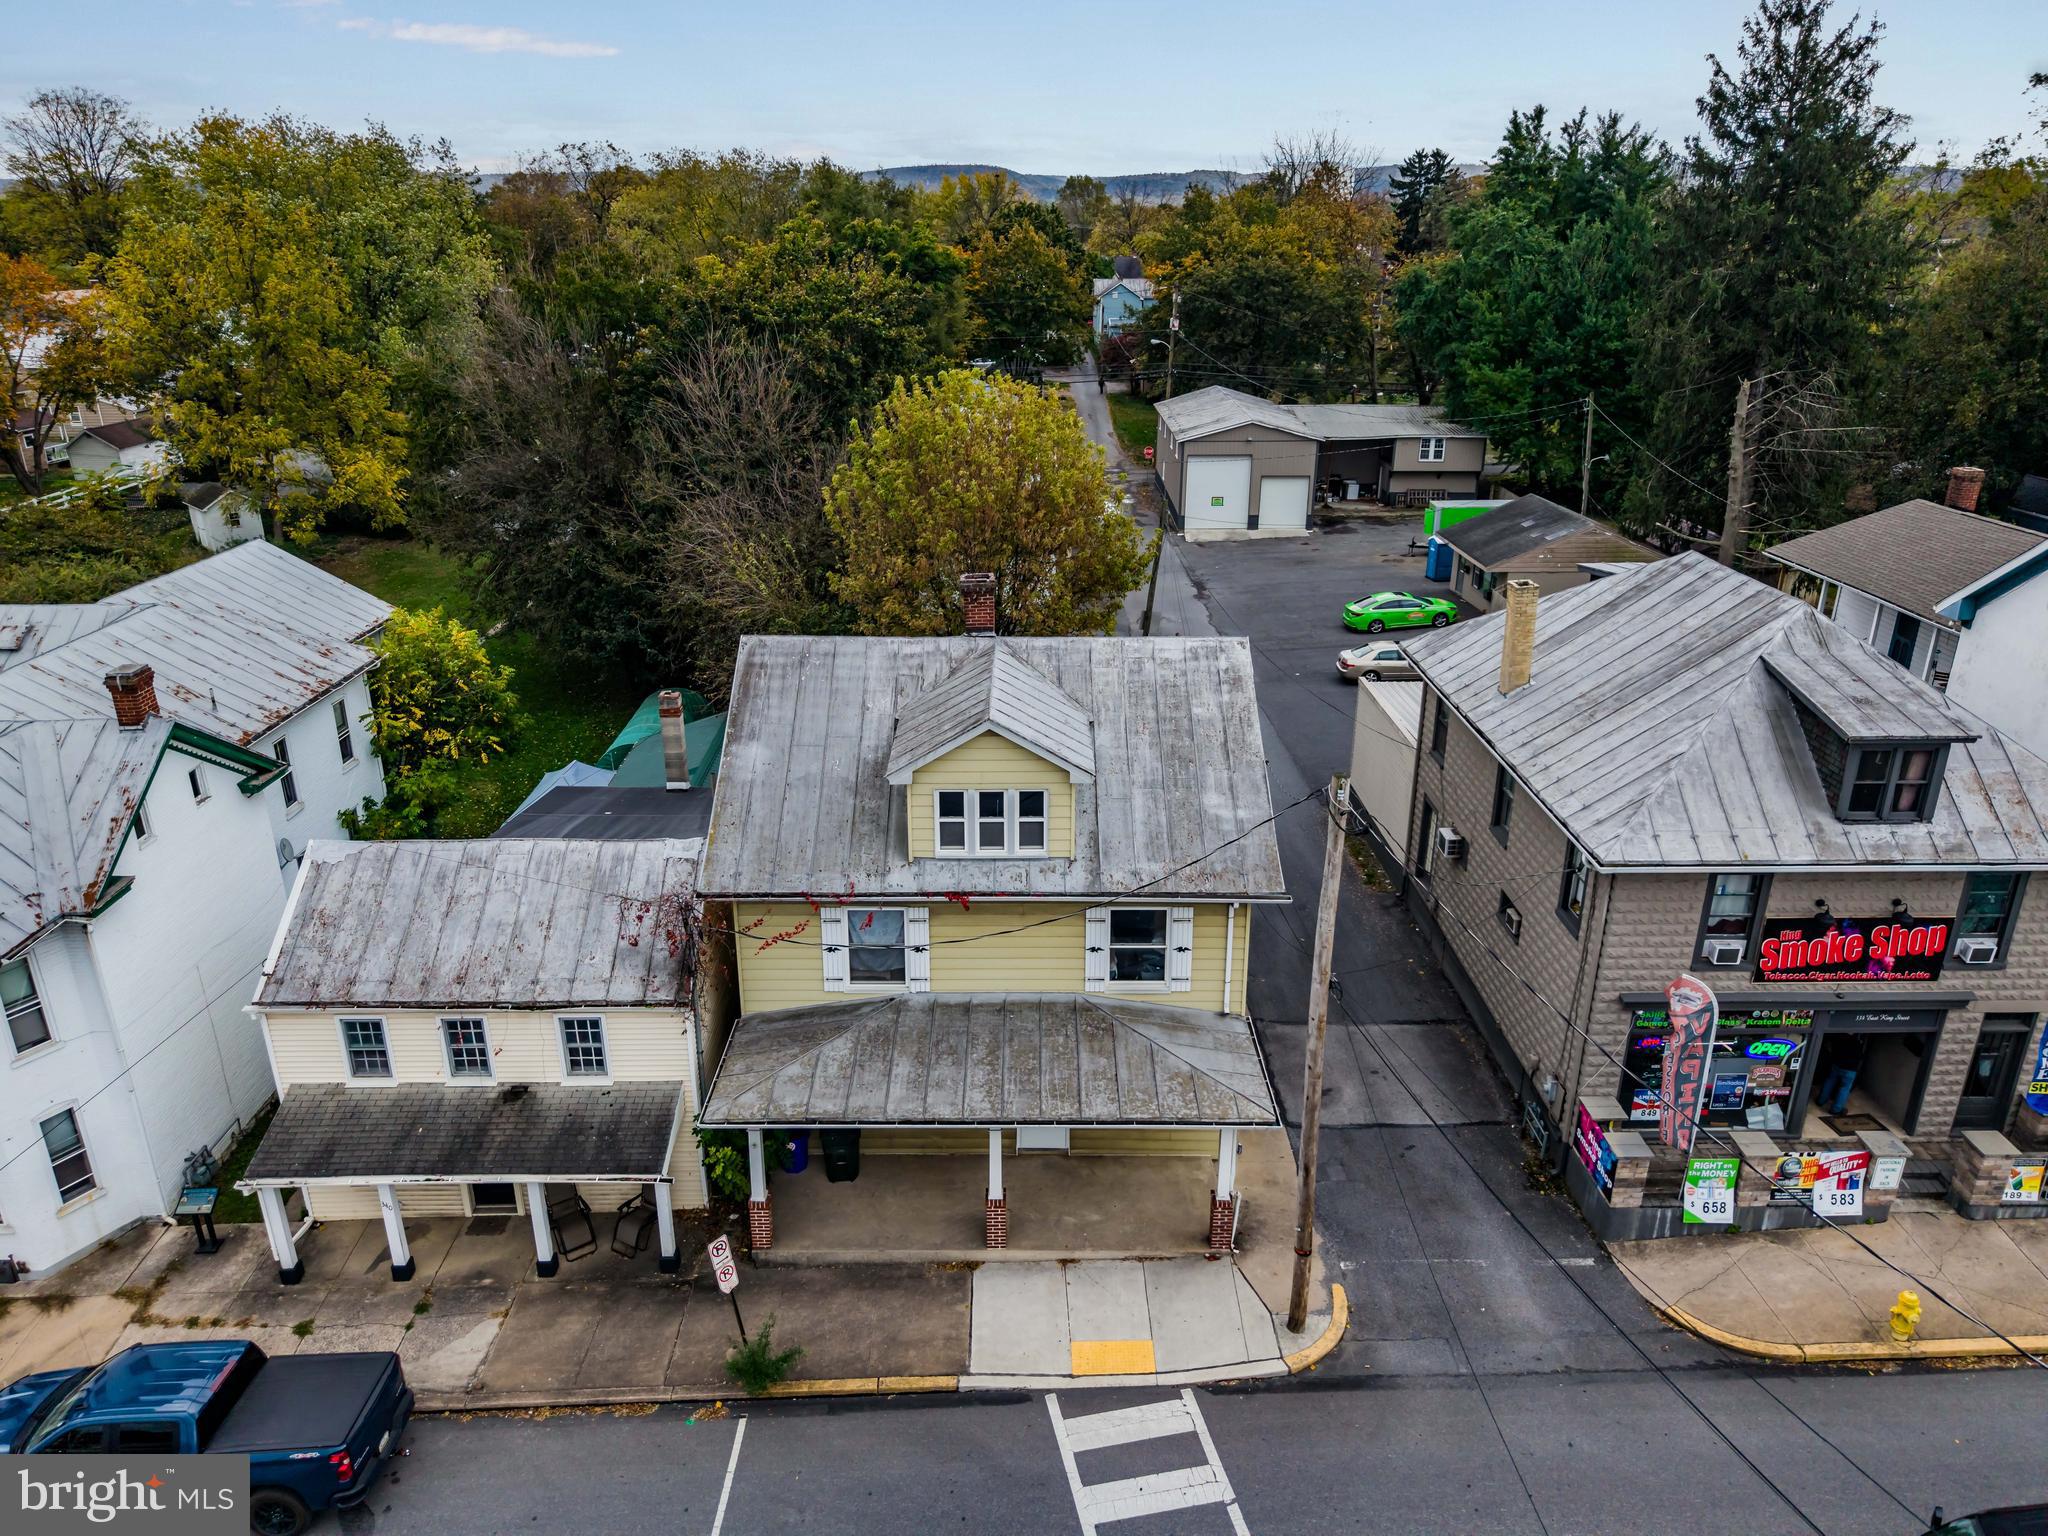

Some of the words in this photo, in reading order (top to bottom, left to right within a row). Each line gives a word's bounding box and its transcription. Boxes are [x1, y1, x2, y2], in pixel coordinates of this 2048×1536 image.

[1760, 931, 1864, 971] Smoke
[1869, 924, 1947, 959] Shop
[1749, 1041, 1791, 1057] OPEN
[1693, 1162, 1723, 1170] RIGHT
[1701, 1169, 1736, 1177] MONEY
